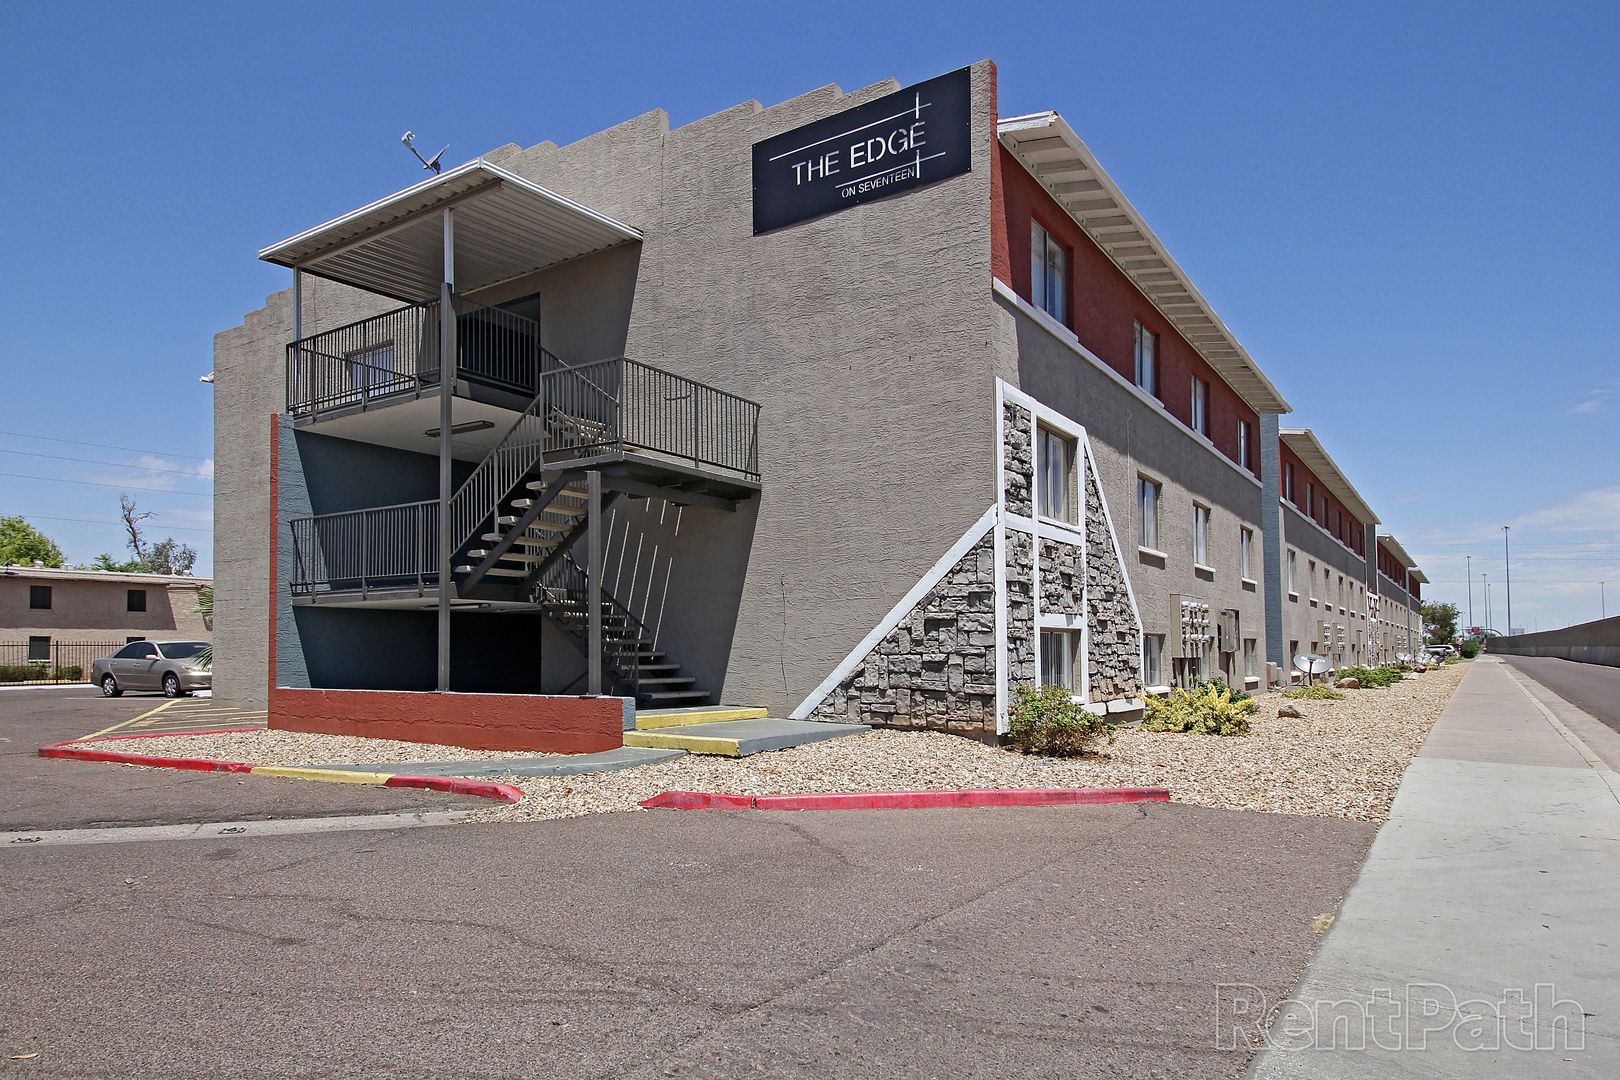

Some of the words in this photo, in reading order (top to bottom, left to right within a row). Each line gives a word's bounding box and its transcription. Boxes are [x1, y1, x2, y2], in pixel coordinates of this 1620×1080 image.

[791, 150, 840, 186] THE
[850, 121, 926, 169] EDGE
[841, 186, 856, 198] ON
[858, 166, 915, 193] SEVENTEEN
